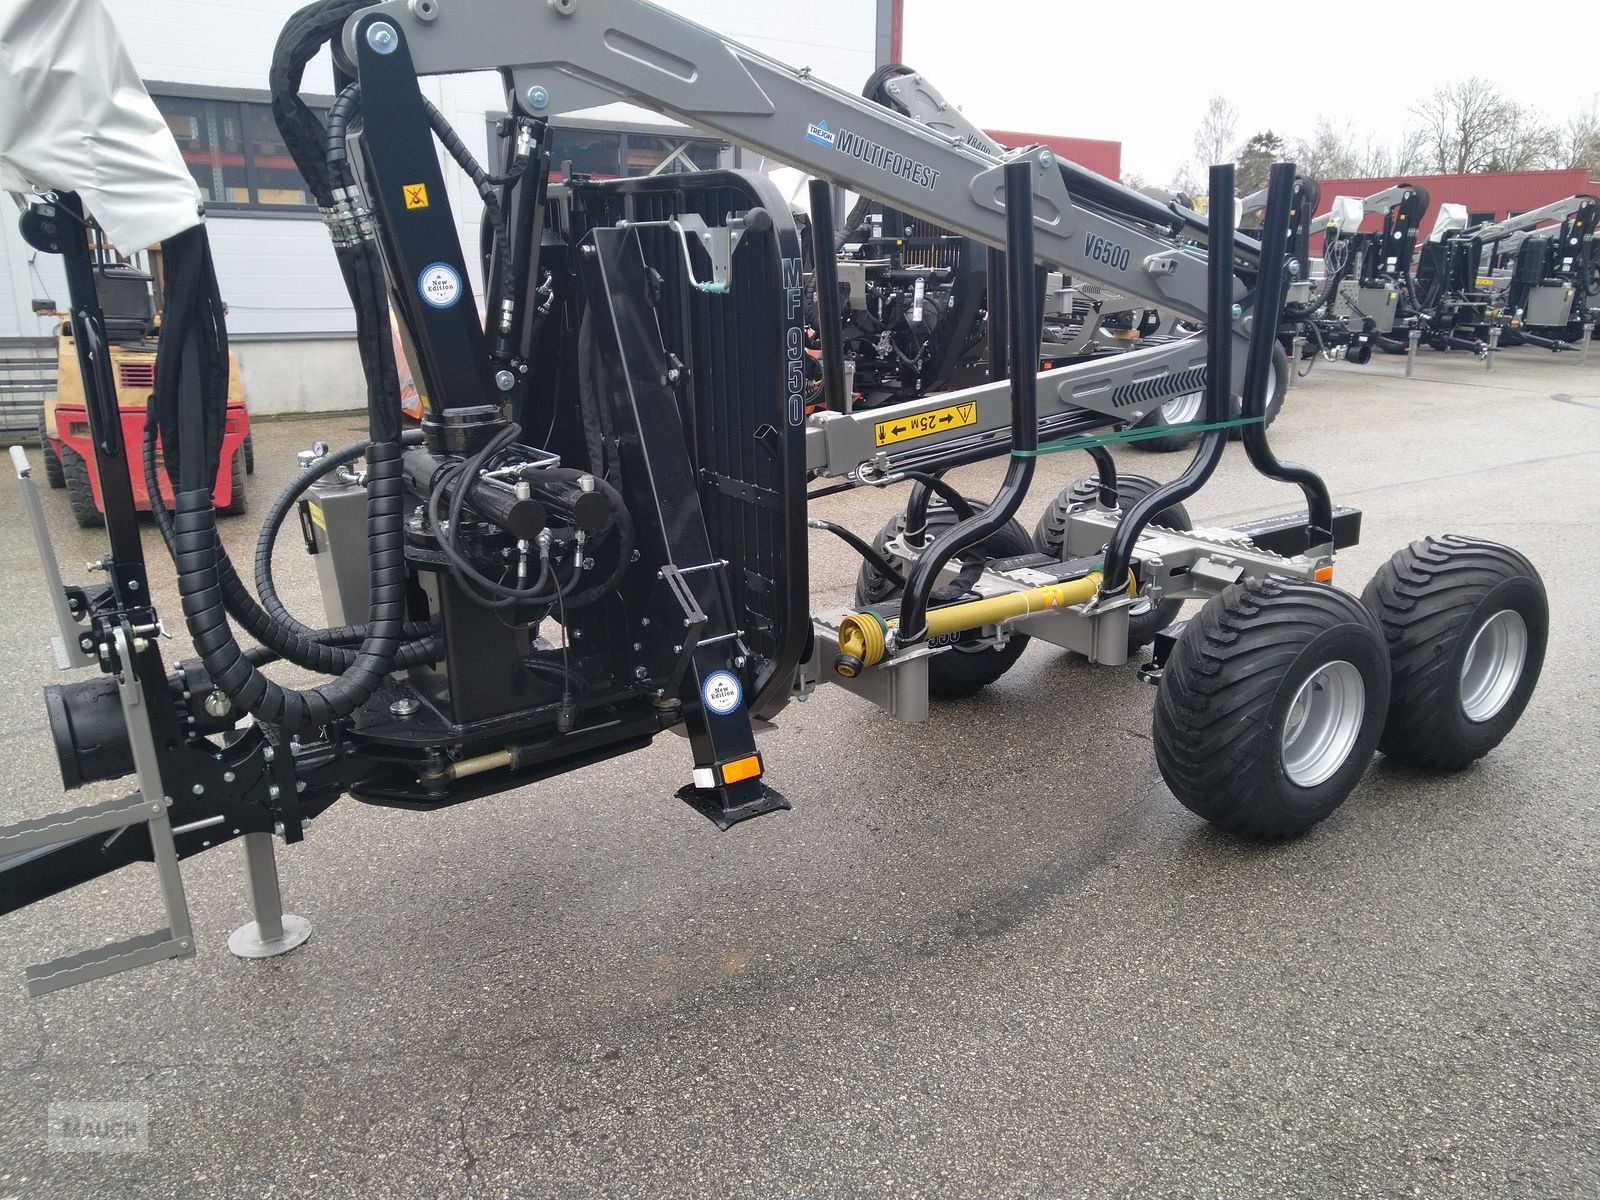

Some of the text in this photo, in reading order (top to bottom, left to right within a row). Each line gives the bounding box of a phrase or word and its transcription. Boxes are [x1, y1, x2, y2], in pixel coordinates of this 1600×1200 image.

[809, 126, 833, 141] TREJON
[836, 128, 940, 191] MULTIFOREST
[1084, 231, 1130, 272] V6500
[781, 258, 804, 427] MF 950
[711, 691, 735, 700] Edition
